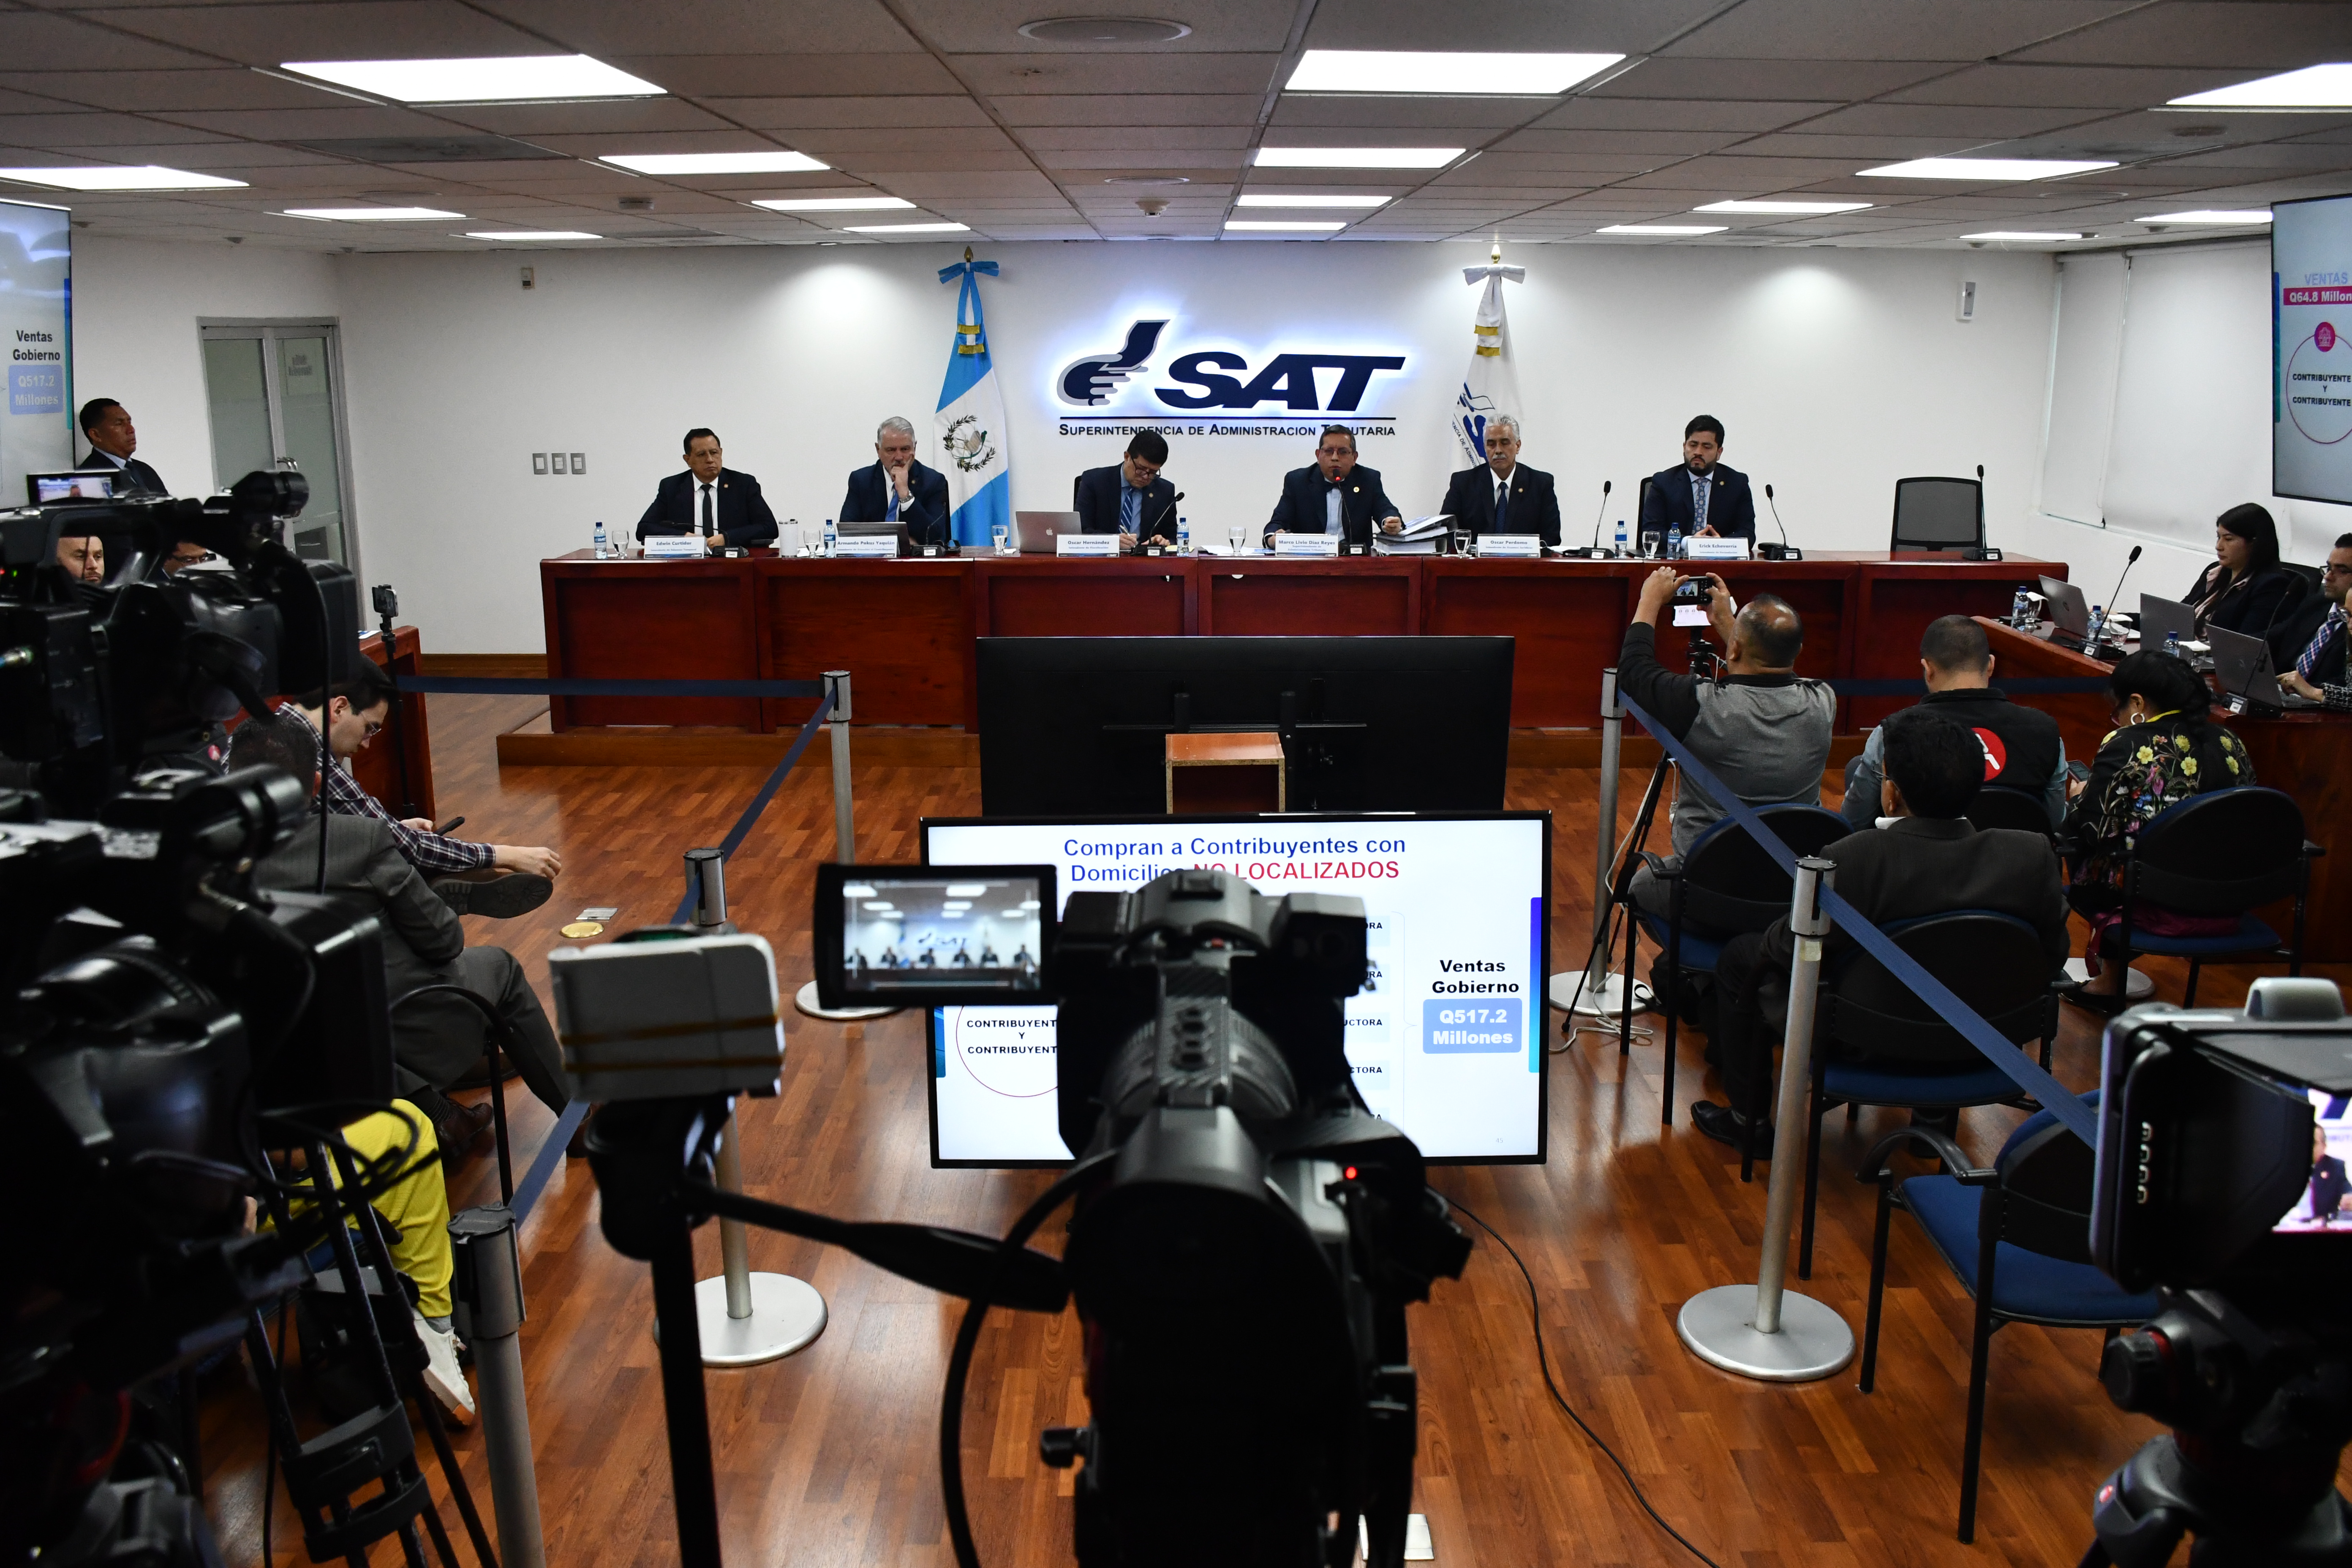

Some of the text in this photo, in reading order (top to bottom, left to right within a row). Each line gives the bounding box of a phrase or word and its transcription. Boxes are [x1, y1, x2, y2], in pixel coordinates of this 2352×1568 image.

[2305, 272, 2348, 286] VENTAS
[2289, 290, 2352, 302] Q64.8 Millon
[16, 330, 53, 342] Ventas
[13, 349, 60, 360] Gobierno
[18, 375, 55, 387] Q517.2
[1154, 351, 1406, 411] SAT
[15, 394, 58, 406] Millones
[1188, 426, 1205, 435] DE
[1064, 837, 1406, 859] Compran a Contribuyentes con
[1072, 864, 1184, 881] Domicilio
[1235, 861, 1399, 880] LOCALIZADOS
[1439, 960, 1505, 972] Ventas
[1432, 980, 1519, 993] Gobierno
[1440, 1009, 1507, 1024] Q517.2
[1433, 1031, 1513, 1044] Millones
